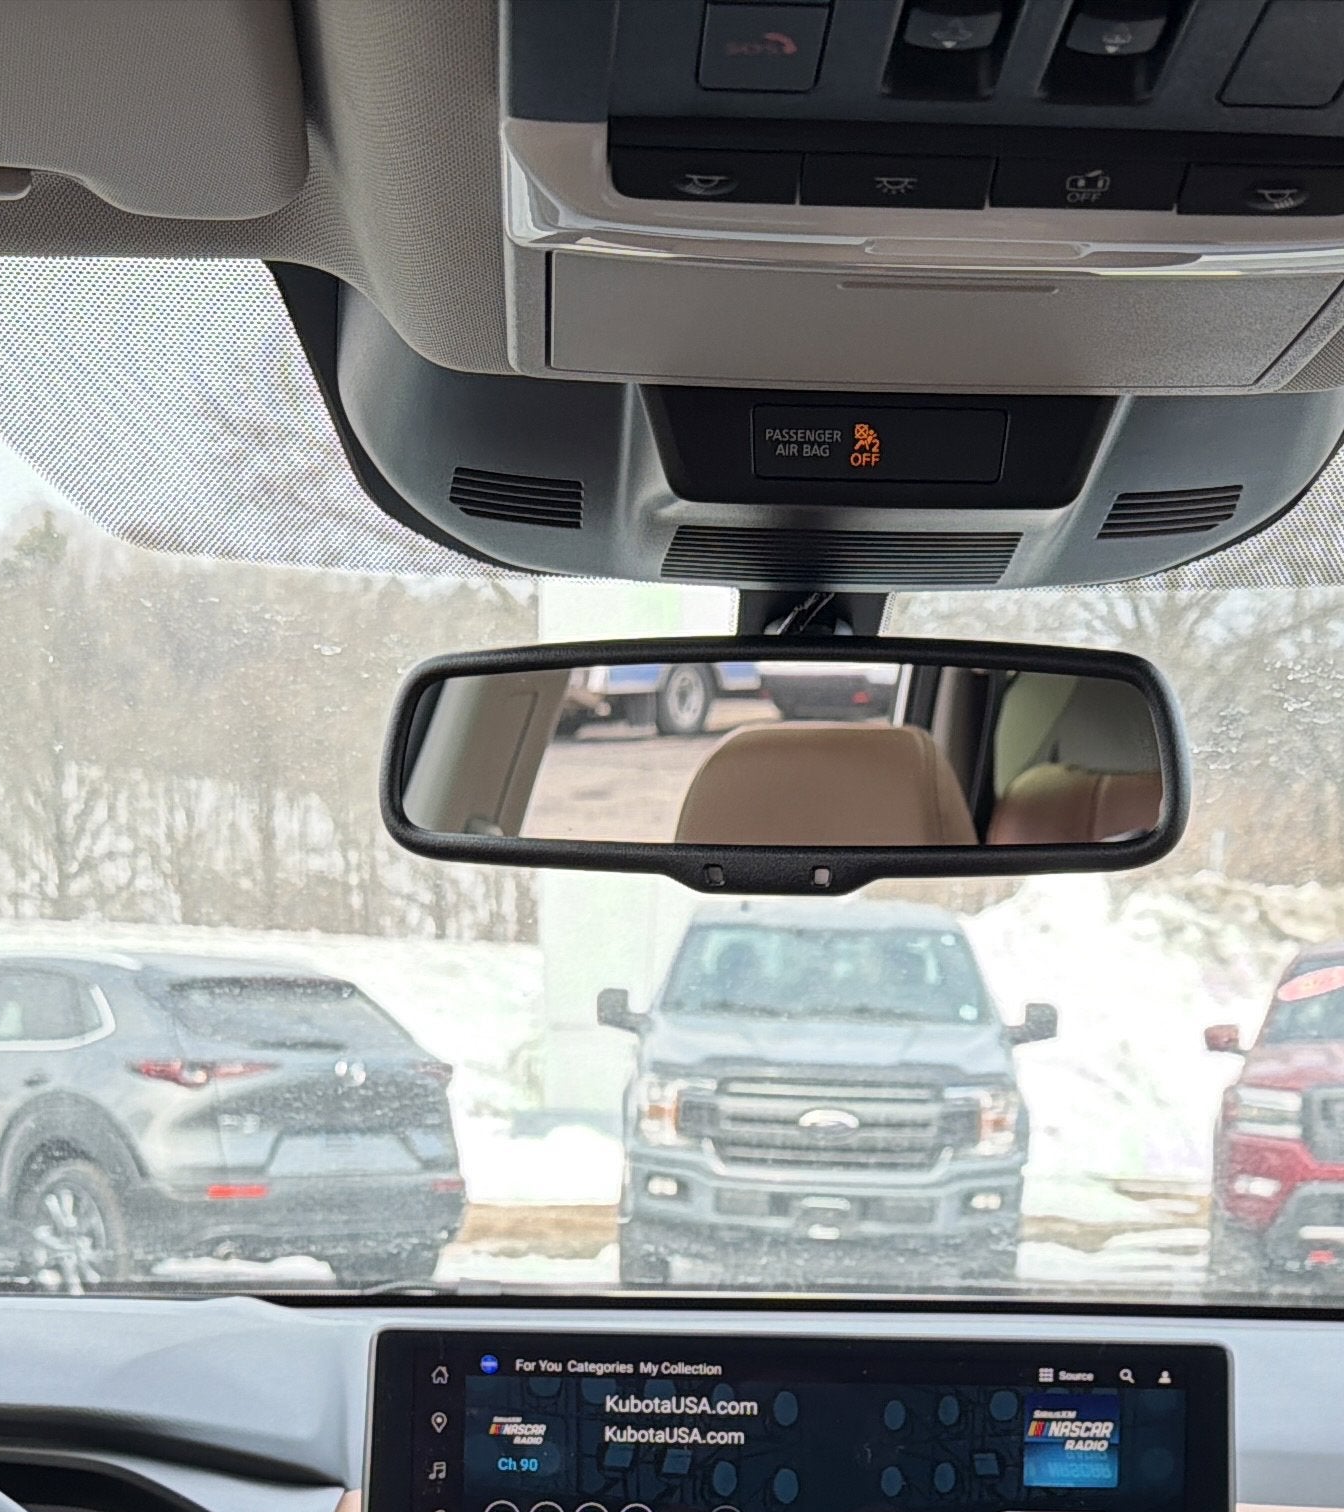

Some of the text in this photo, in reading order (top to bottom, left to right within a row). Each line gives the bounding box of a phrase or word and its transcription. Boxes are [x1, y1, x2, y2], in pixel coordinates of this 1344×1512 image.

[765, 429, 842, 443] PASSENGER
[775, 443, 831, 458] AIR BAG
[850, 452, 881, 467] OFF
[515, 1358, 723, 1376] For You Categories My Collection
[1059, 1371, 1095, 1383] Source
[604, 1396, 758, 1416] KubotaUSA.com
[604, 1426, 745, 1446] KubotaUSA.com
[1048, 1420, 1115, 1439] NASCAR
[513, 1435, 544, 1446] RADIO
[1064, 1440, 1109, 1452] RADIO
[497, 1457, 539, 1471] Ch 90
